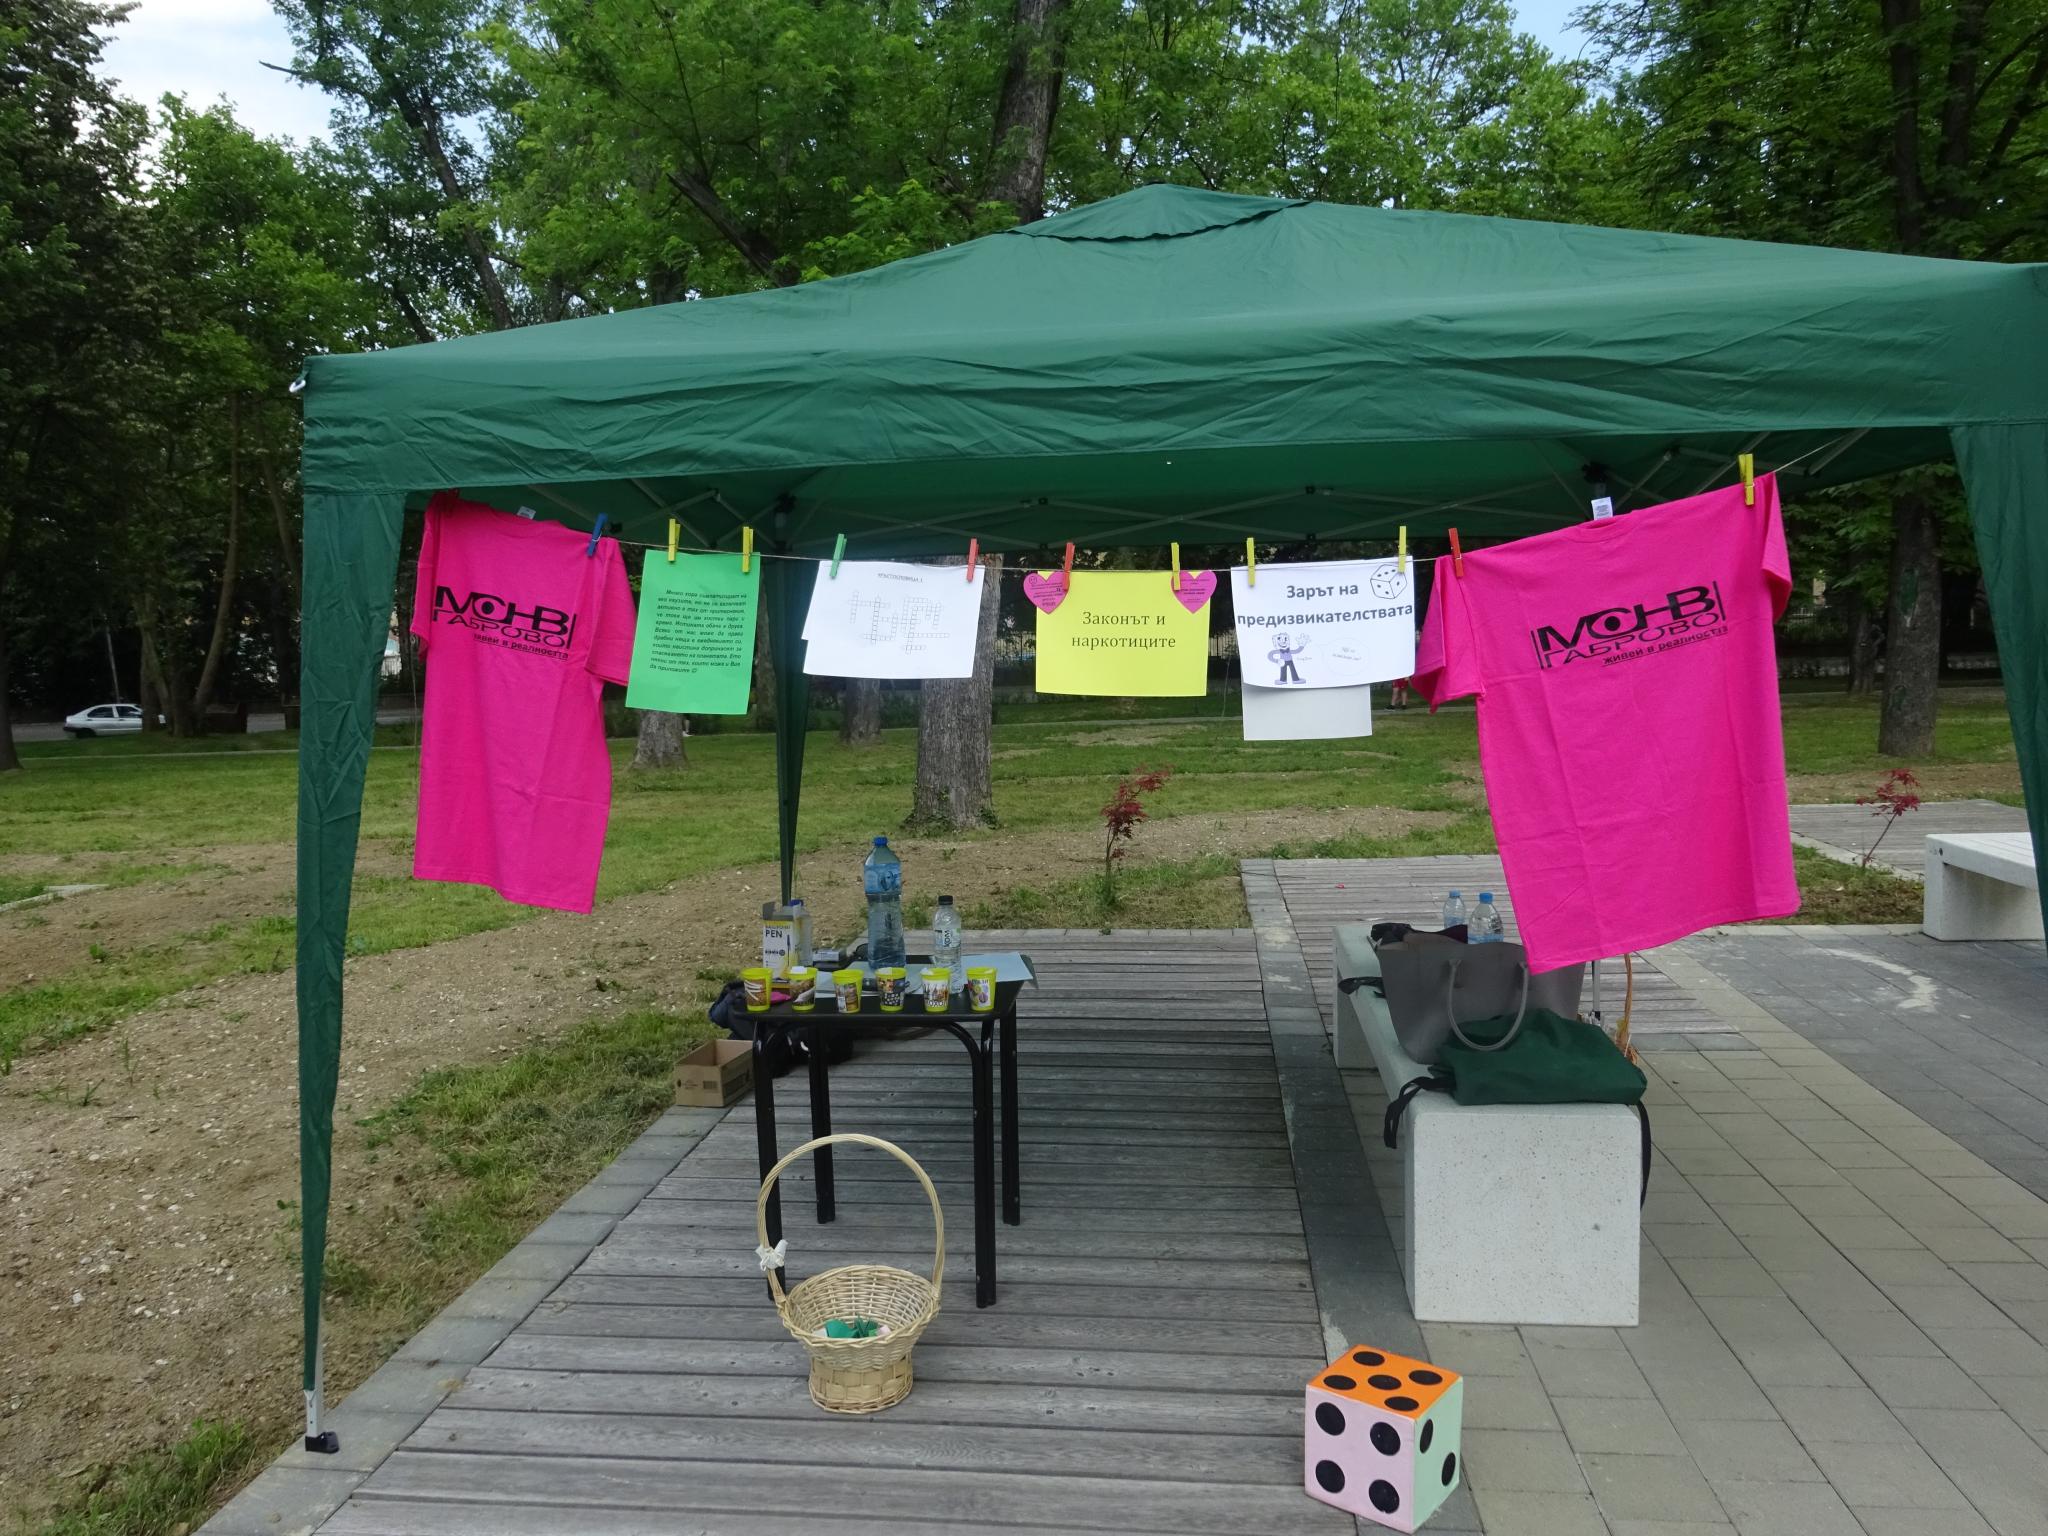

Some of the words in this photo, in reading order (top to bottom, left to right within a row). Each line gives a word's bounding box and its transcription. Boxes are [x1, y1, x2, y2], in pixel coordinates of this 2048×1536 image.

[1286, 585, 1334, 601] Зарът
[1339, 584, 1359, 595] на
[1082, 611, 1150, 625] Законът
[1155, 616, 1166, 625] и
[1237, 604, 1413, 628] предизвикателствата
[432, 608, 565, 647] ГАБРОВО
[1071, 636, 1176, 650] наркотиците
[1544, 612, 1719, 668] ГАБРОВО
[511, 641, 569, 659] реалността
[1603, 647, 1644, 665] живей
[1647, 644, 1655, 653] в
[765, 929, 783, 938] PEN
